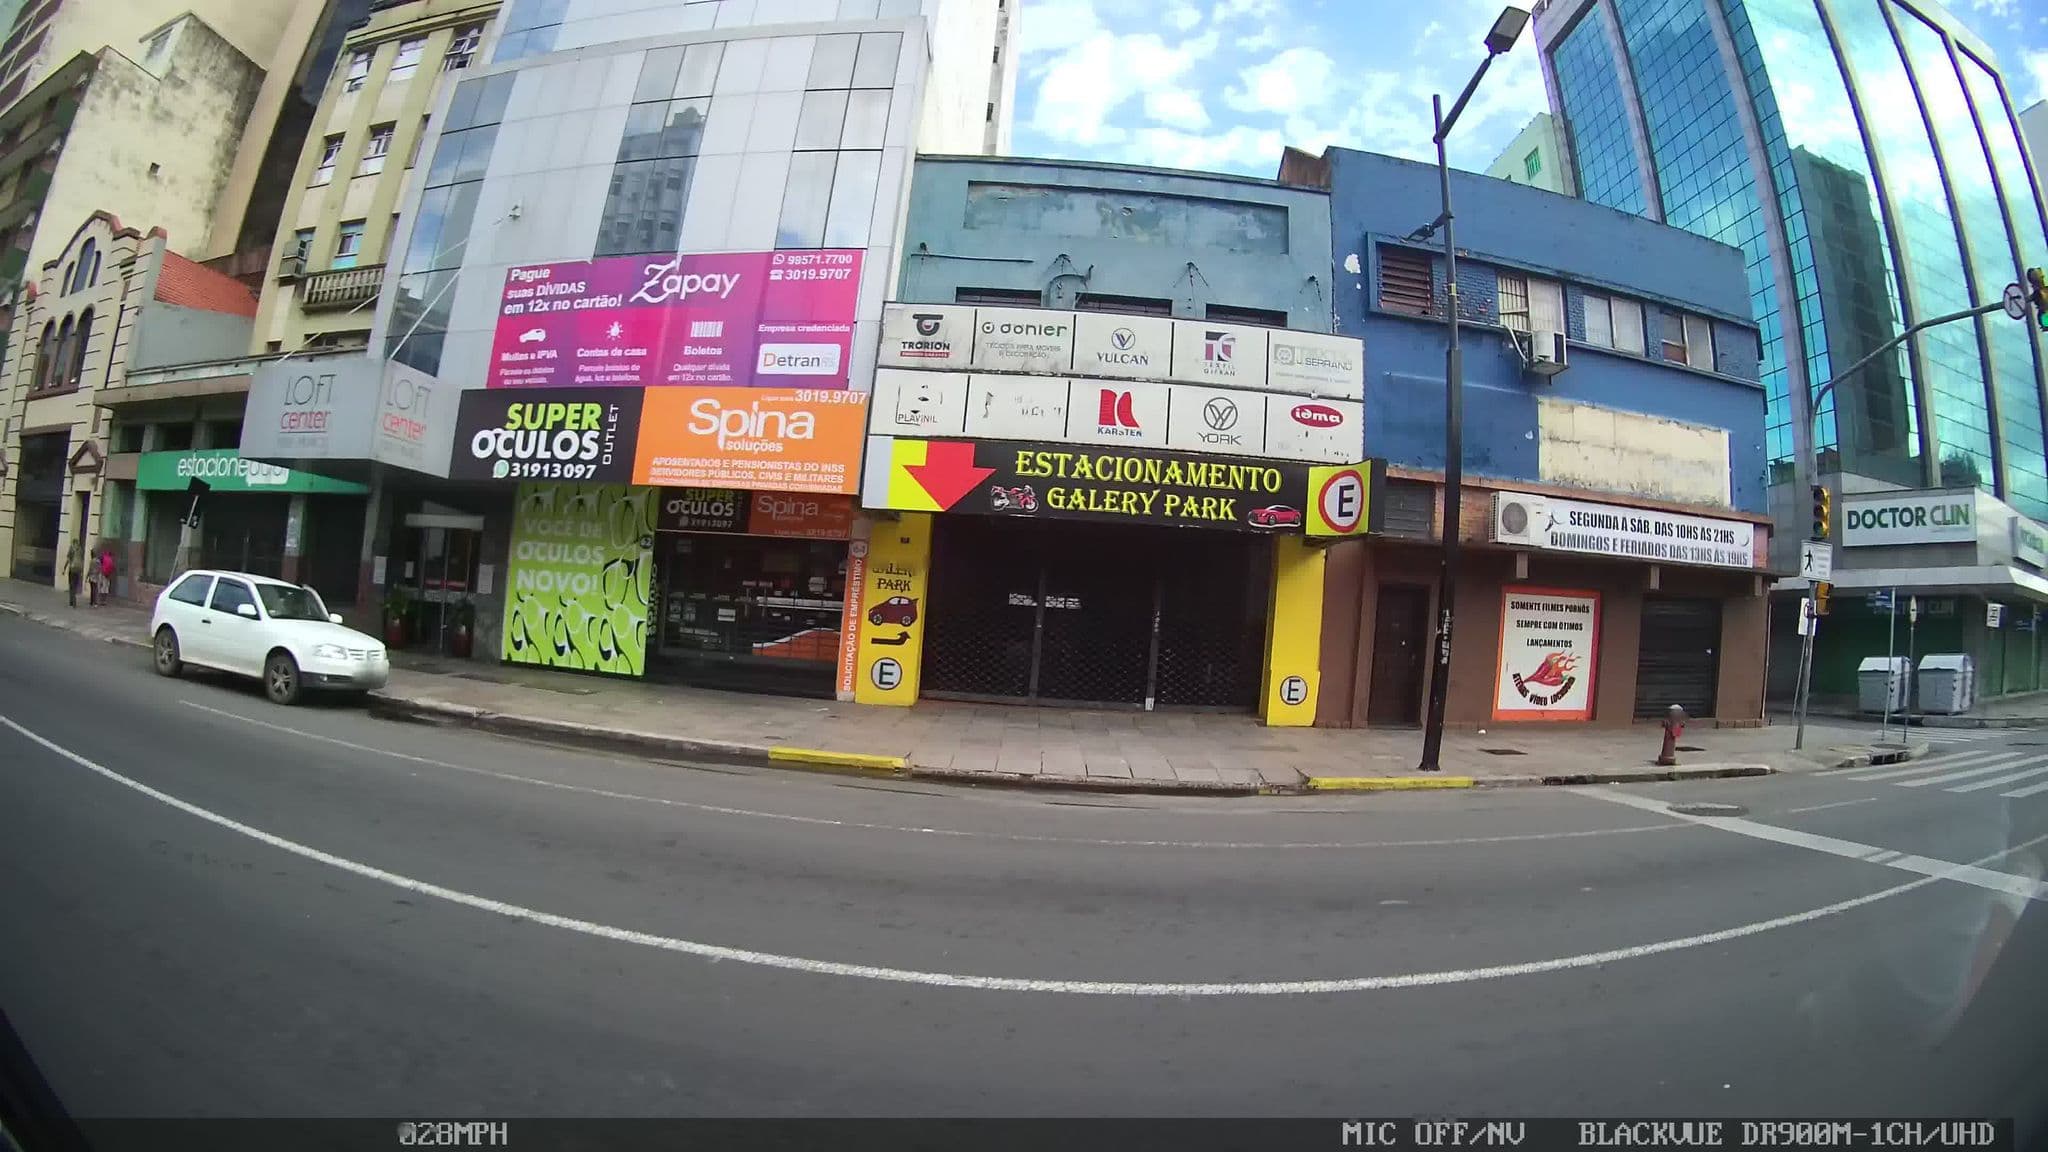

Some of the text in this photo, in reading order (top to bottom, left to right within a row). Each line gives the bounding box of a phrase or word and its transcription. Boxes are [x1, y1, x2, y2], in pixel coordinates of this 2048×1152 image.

[787, 254, 852, 264] 99571.7700
[510, 268, 550, 283] Pague
[629, 254, 740, 305] Zapay
[785, 269, 851, 281] 3019.9707
[507, 281, 586, 300] suas DÍVIDAS
[504, 294, 622, 315] em 12x no cartão!
[683, 345, 723, 355] Boletos
[1097, 352, 1148, 366] VULCAN
[284, 373, 337, 410] LOFT
[795, 389, 867, 404] 3019.9707
[281, 411, 331, 430] center
[505, 402, 602, 430] SUPER
[687, 398, 815, 450] Spina
[382, 412, 426, 440] center
[603, 404, 619, 465] OUTLET
[726, 440, 783, 454] soluções
[1198, 430, 1243, 446] YORK
[510, 463, 597, 479] 31913097
[803, 463, 818, 471] DO
[1015, 450, 1284, 494] ESTACIONAMENTO
[793, 473, 844, 484] MILITARES
[757, 495, 818, 520] Spina
[1046, 487, 1237, 521] GALERY PARK
[1337, 484, 1355, 518] E
[1847, 503, 1970, 530] DOCTOR CLIN
[1569, 510, 1619, 531] SEGUNDA
[1621, 516, 1628, 531] A
[1654, 523, 1674, 537] DAS
[1675, 525, 1699, 540] 10HS
[1714, 529, 1735, 545] 21HS
[1550, 531, 1610, 551] DOMINGOS
[1612, 539, 1618, 552] E
[1620, 539, 1668, 558] FERIADOS
[1669, 544, 1688, 561] DAS
[517, 568, 598, 596] NOVO!
[877, 578, 911, 592] PARK
[1511, 601, 1541, 612] SOMENTE
[1542, 603, 1564, 612] FILMES
[848, 617, 859, 631] DE
[1516, 620, 1542, 629] SEMPRE
[1543, 621, 1558, 630] COM
[1526, 638, 1573, 649] LANÇAMENTOS
[879, 661, 895, 686] E
[1286, 678, 1302, 702] E
